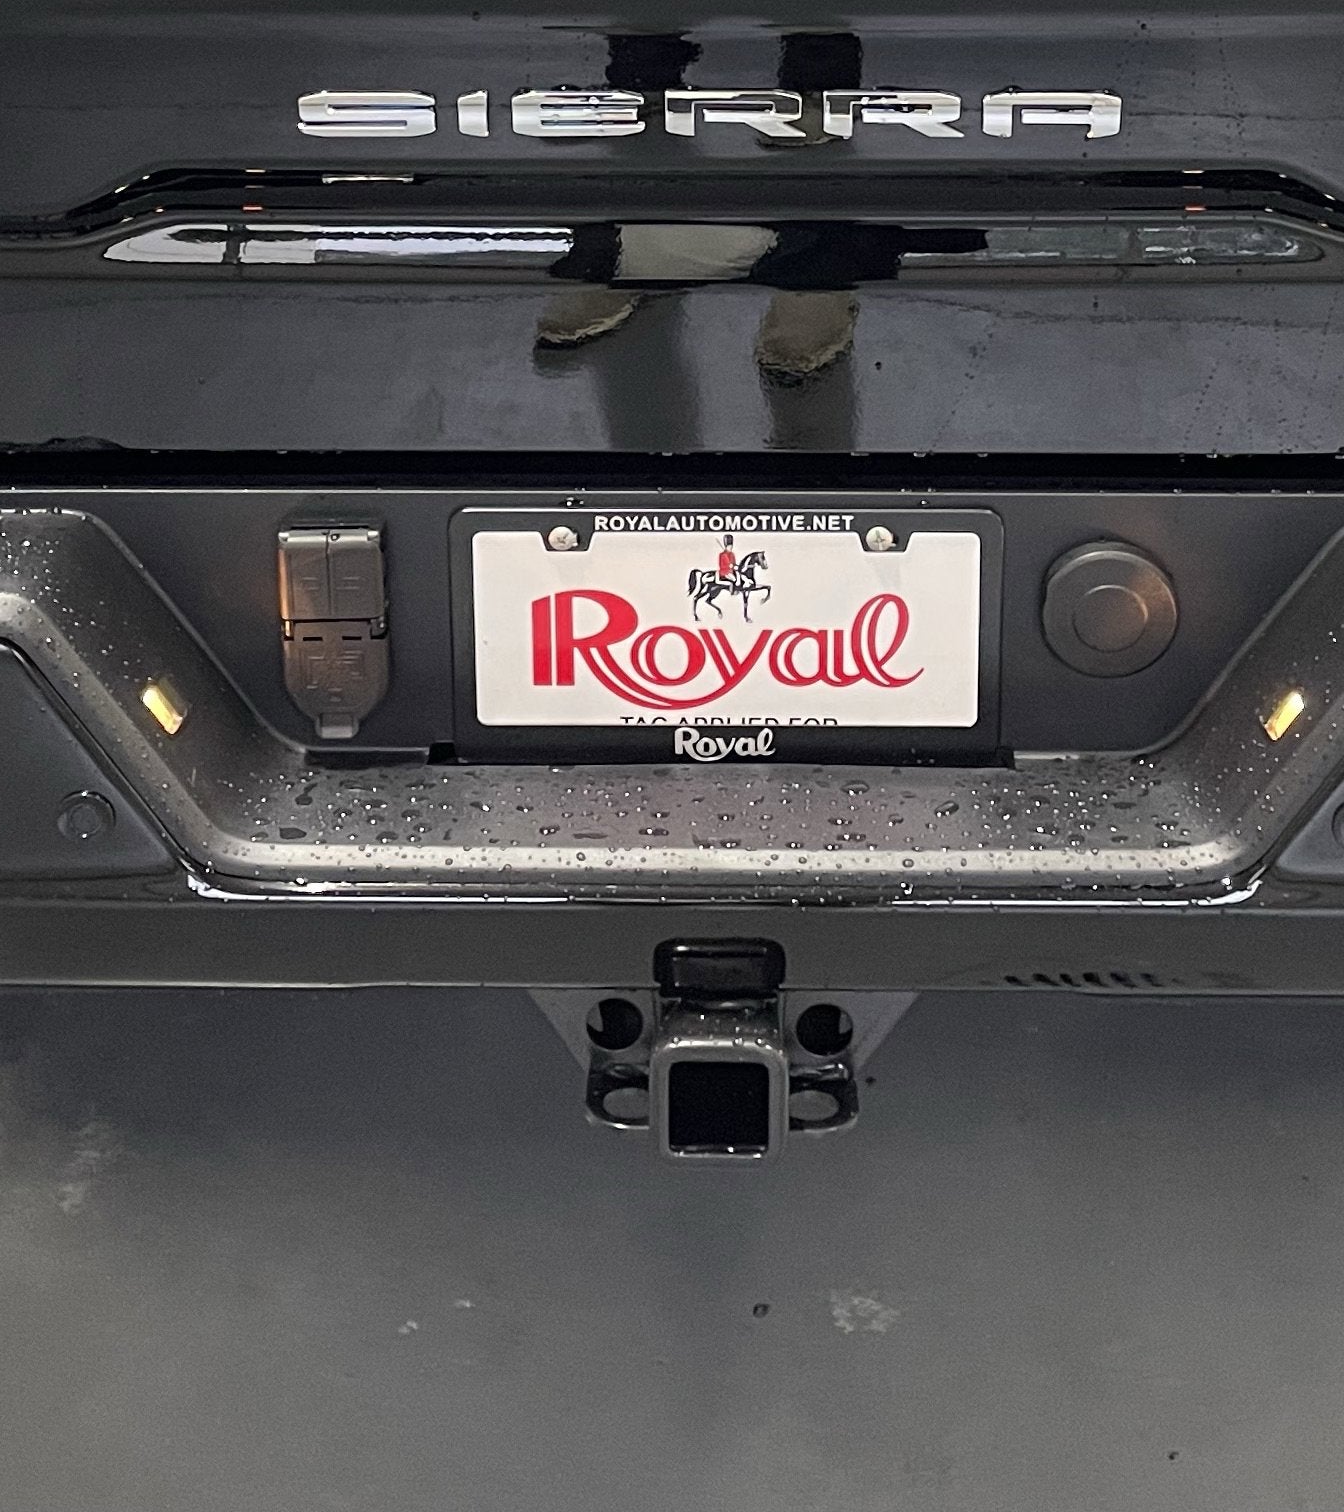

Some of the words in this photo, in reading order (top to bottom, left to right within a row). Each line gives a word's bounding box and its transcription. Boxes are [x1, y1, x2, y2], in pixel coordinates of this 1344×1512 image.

[297, 88, 1123, 138] SIERRA
[594, 514, 855, 531] ROYALAUTOMOTIVE.NET
[531, 589, 924, 710] Royal
[674, 726, 776, 762] Royal
